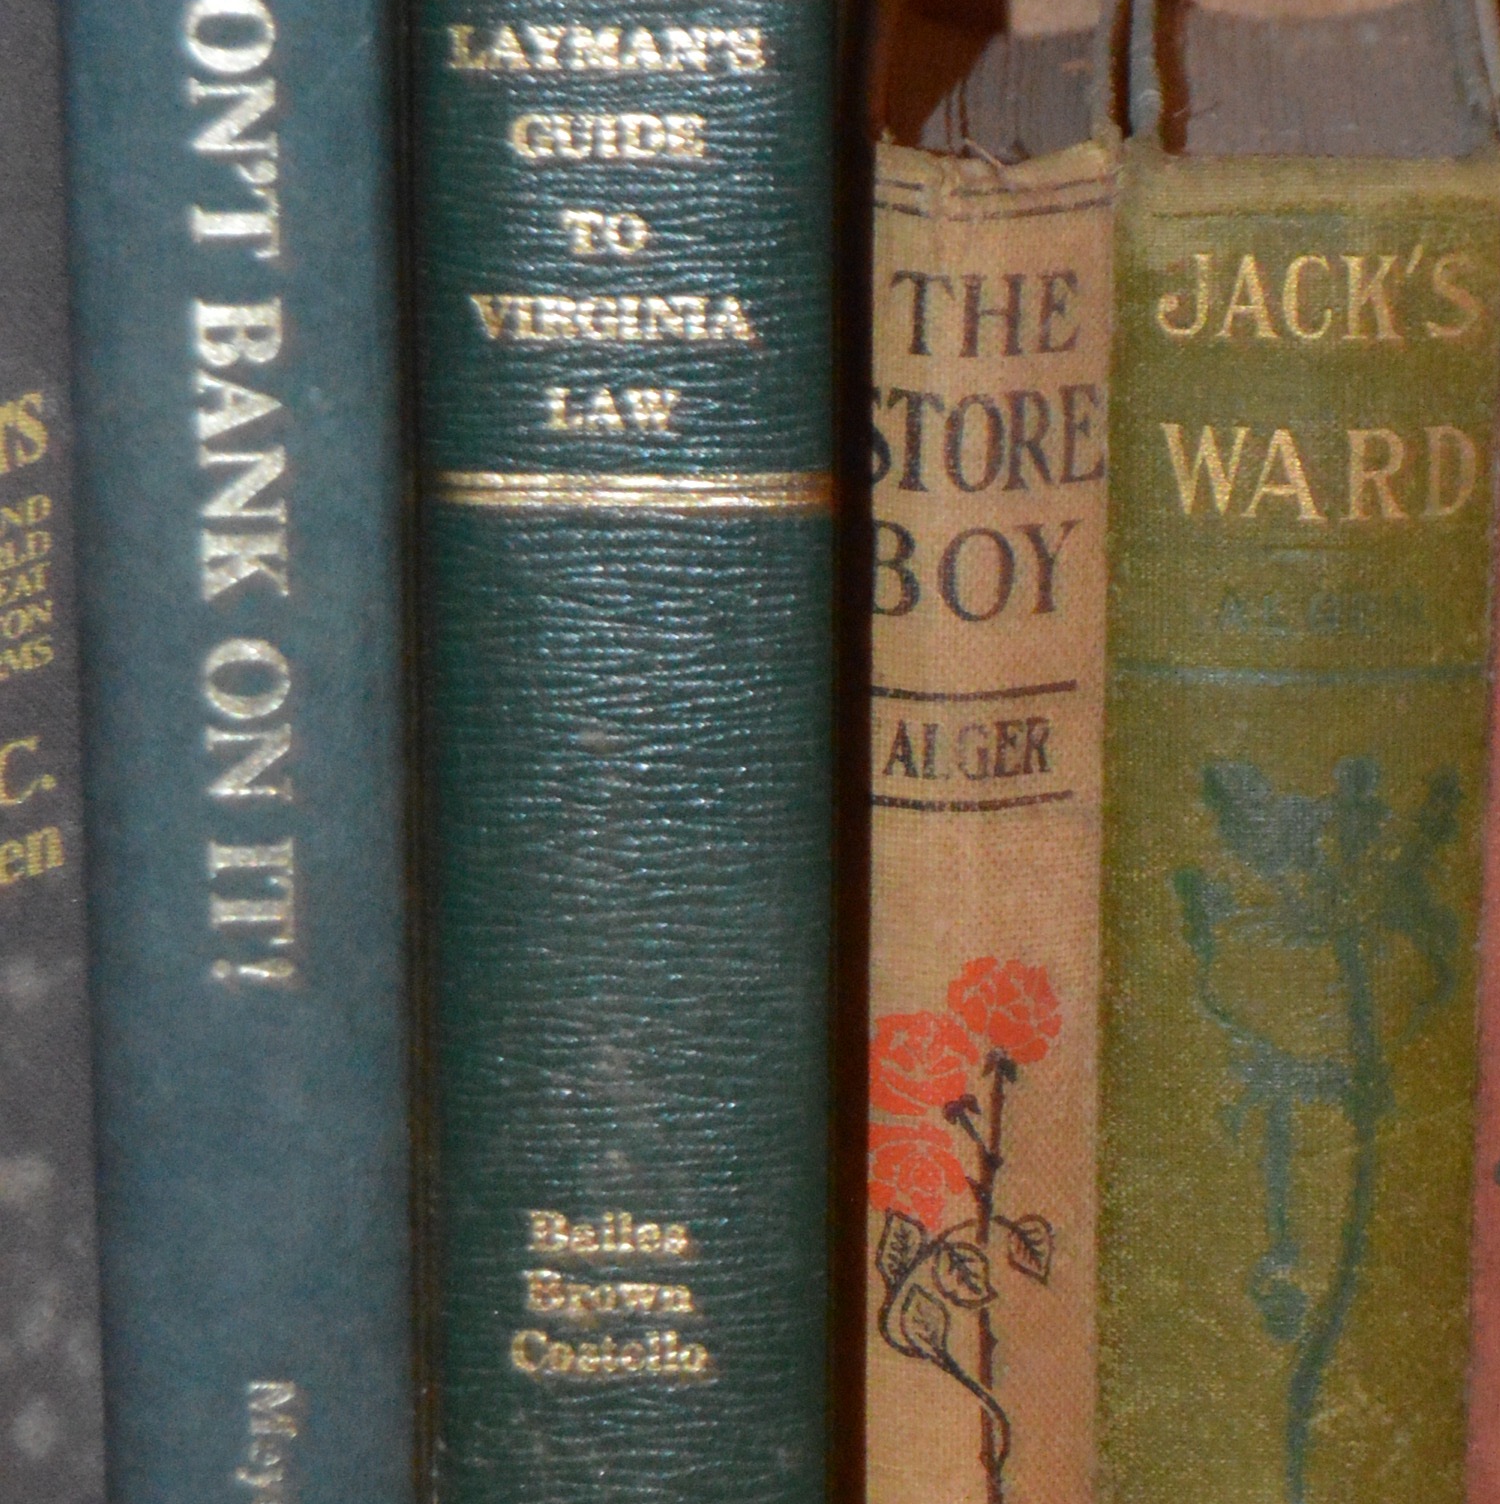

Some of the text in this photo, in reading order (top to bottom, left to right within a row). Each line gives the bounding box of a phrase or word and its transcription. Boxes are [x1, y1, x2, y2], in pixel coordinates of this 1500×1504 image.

[447, 24, 766, 73] LAYMAN'S
[510, 112, 707, 160] GUIDE
[562, 209, 651, 255] TO
[469, 294, 758, 342] VIRGINIA
[891, 268, 1079, 359] THE
[1155, 244, 1491, 341] JACK'S
[544, 386, 681, 431] LAW
[194, 298, 291, 602] BANK
[1158, 422, 1478, 525] WARD
[872, 517, 1082, 623] BOY
[204, 637, 293, 801] ON
[881, 714, 1054, 782] ALGER
[209, 837, 295, 981] IT!
[526, 1209, 690, 1255] Bailes
[522, 1269, 695, 1314] Brown
[510, 1328, 710, 1373] Costello
